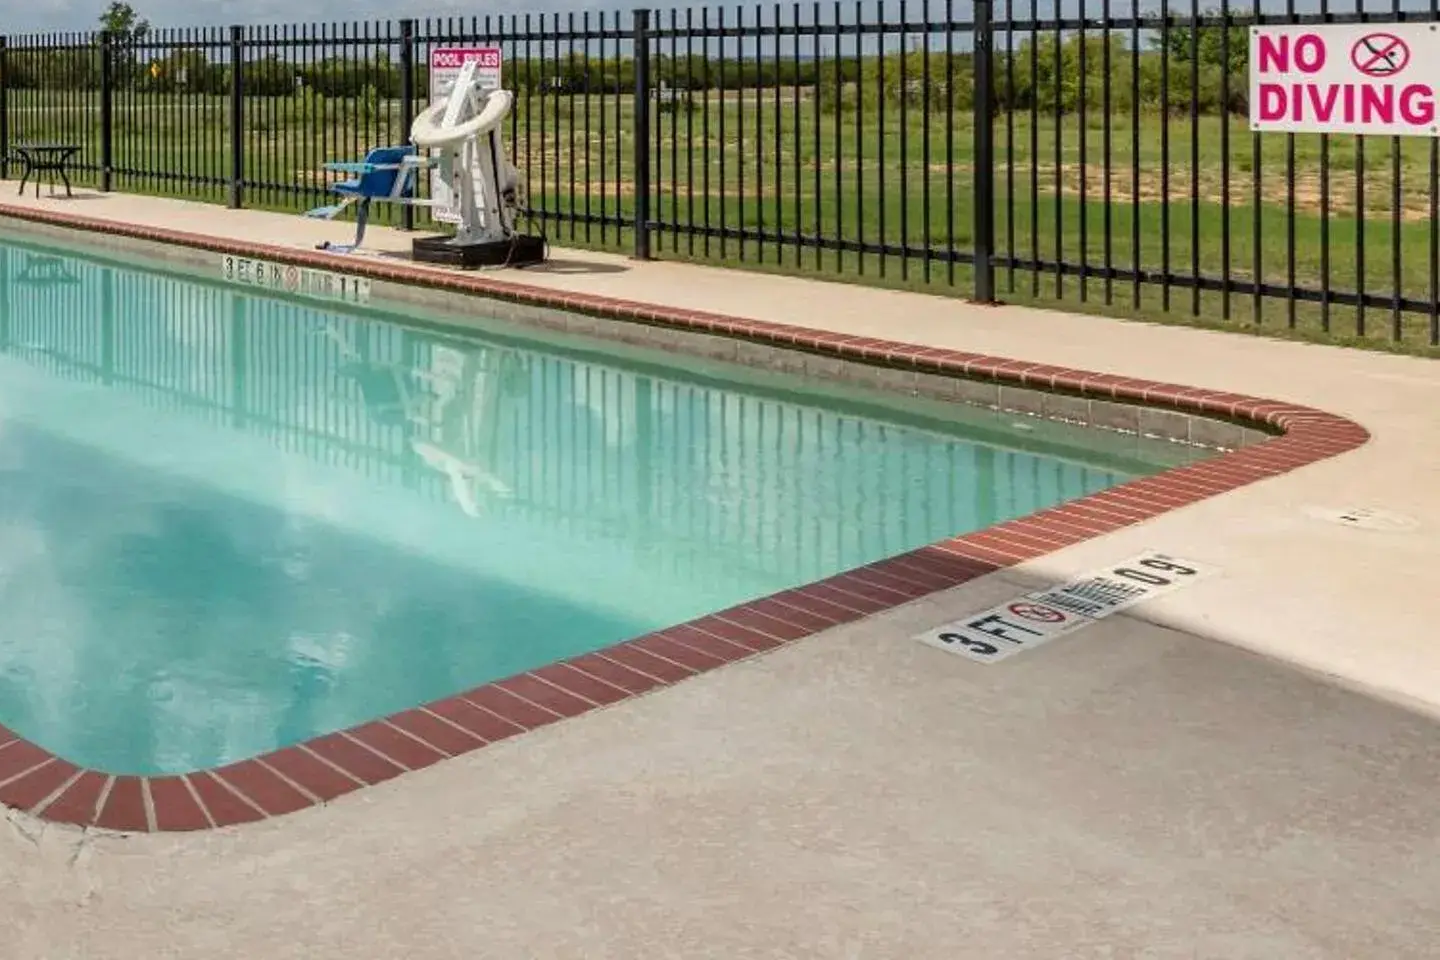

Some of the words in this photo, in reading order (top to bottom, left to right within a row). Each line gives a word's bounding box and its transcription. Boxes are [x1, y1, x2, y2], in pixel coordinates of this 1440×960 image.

[433, 52, 461, 67] POOL
[1258, 33, 1326, 74] NO
[1258, 82, 1436, 126] DIVING
